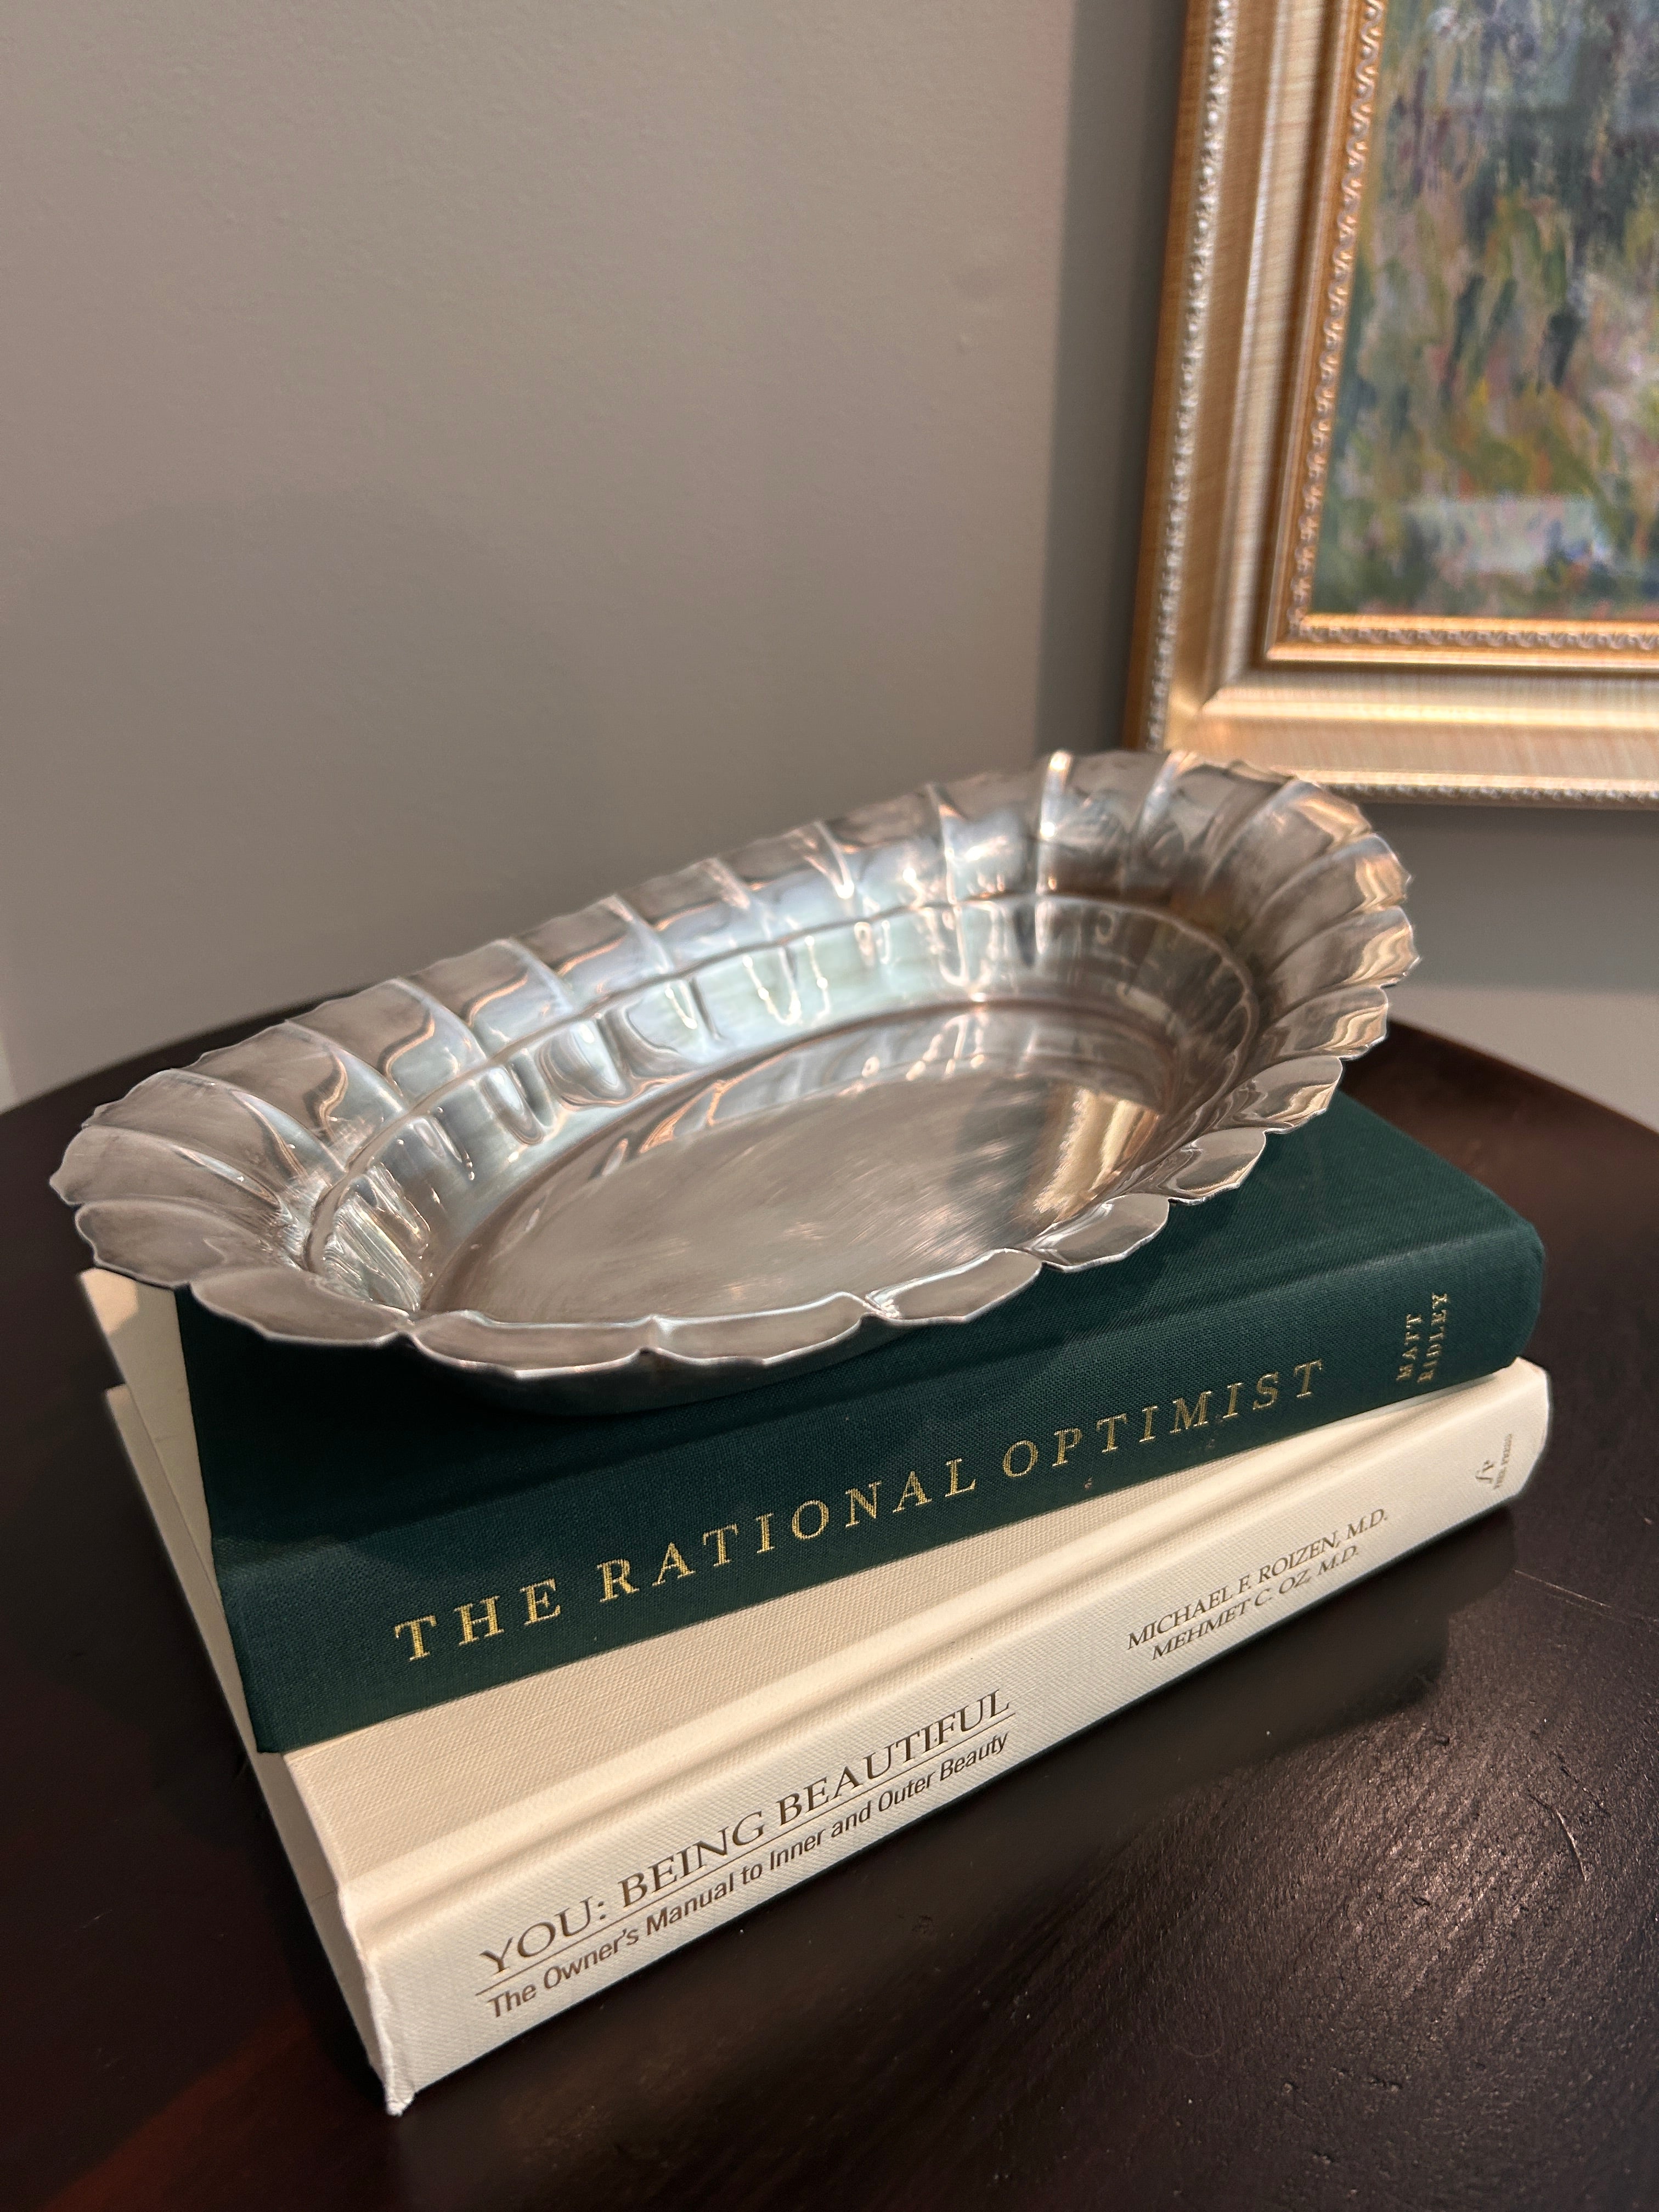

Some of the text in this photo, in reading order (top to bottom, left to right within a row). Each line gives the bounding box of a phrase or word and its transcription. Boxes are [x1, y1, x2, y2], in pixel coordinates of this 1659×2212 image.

[1395, 1313, 1423, 1381] MATT
[393, 1359, 1323, 1661] THE RATIONAL OPTIMIST
[1126, 1508, 1389, 1650] MICHAEL F. ROIZEN, M.D.
[1152, 1599, 1252, 1661] MEHMET
[1254, 1589, 1273, 1607] C.
[1317, 1545, 1359, 1576] M.D.
[479, 1689, 1011, 1974] YOU: BEING BEAUTIFUL
[487, 1732, 1010, 2018] The Owner's Manual to Inner and Outer Beauty
